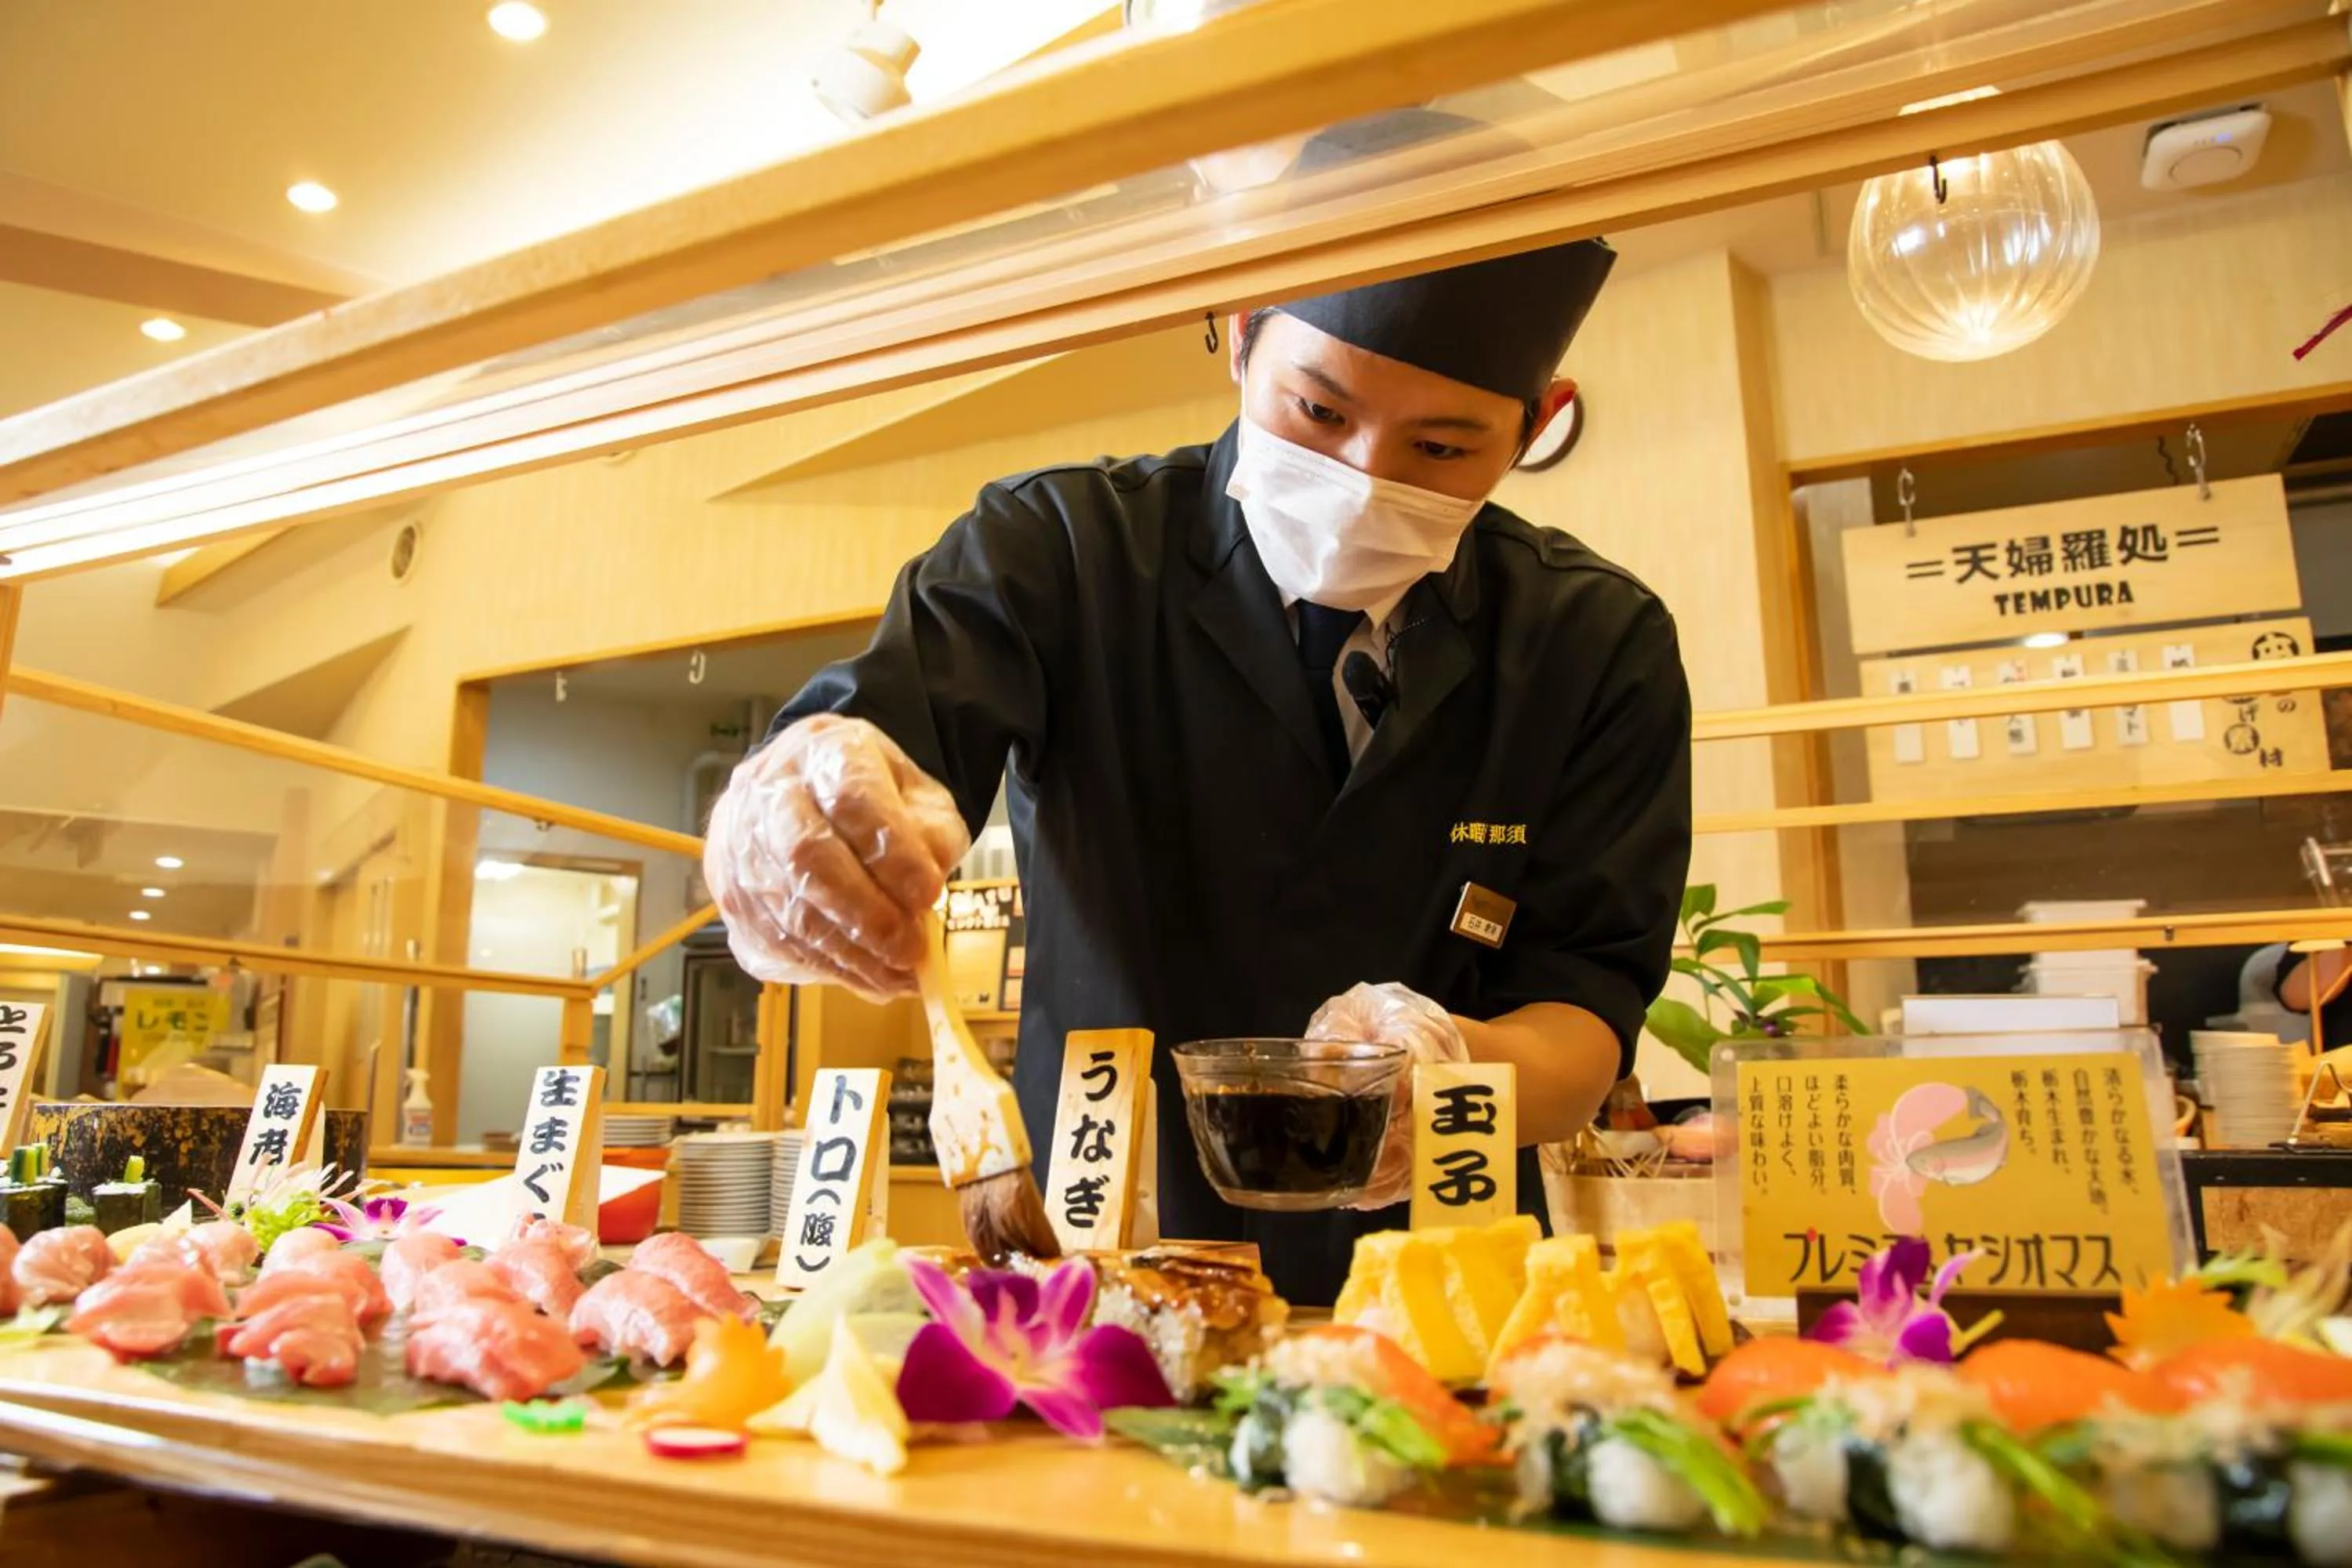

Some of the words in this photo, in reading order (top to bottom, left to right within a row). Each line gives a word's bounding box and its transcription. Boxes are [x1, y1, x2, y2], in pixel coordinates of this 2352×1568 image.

[1952, 524, 2169, 583] 天婦羅処
[1994, 581, 2134, 616] TEMPURA
[523, 1068, 581, 1219] 生まぐ
[1064, 1051, 1119, 1229] うなぎ
[1428, 1083, 1497, 1207] 玉子
[1783, 1226, 2122, 1287] プレミヤシオマス
